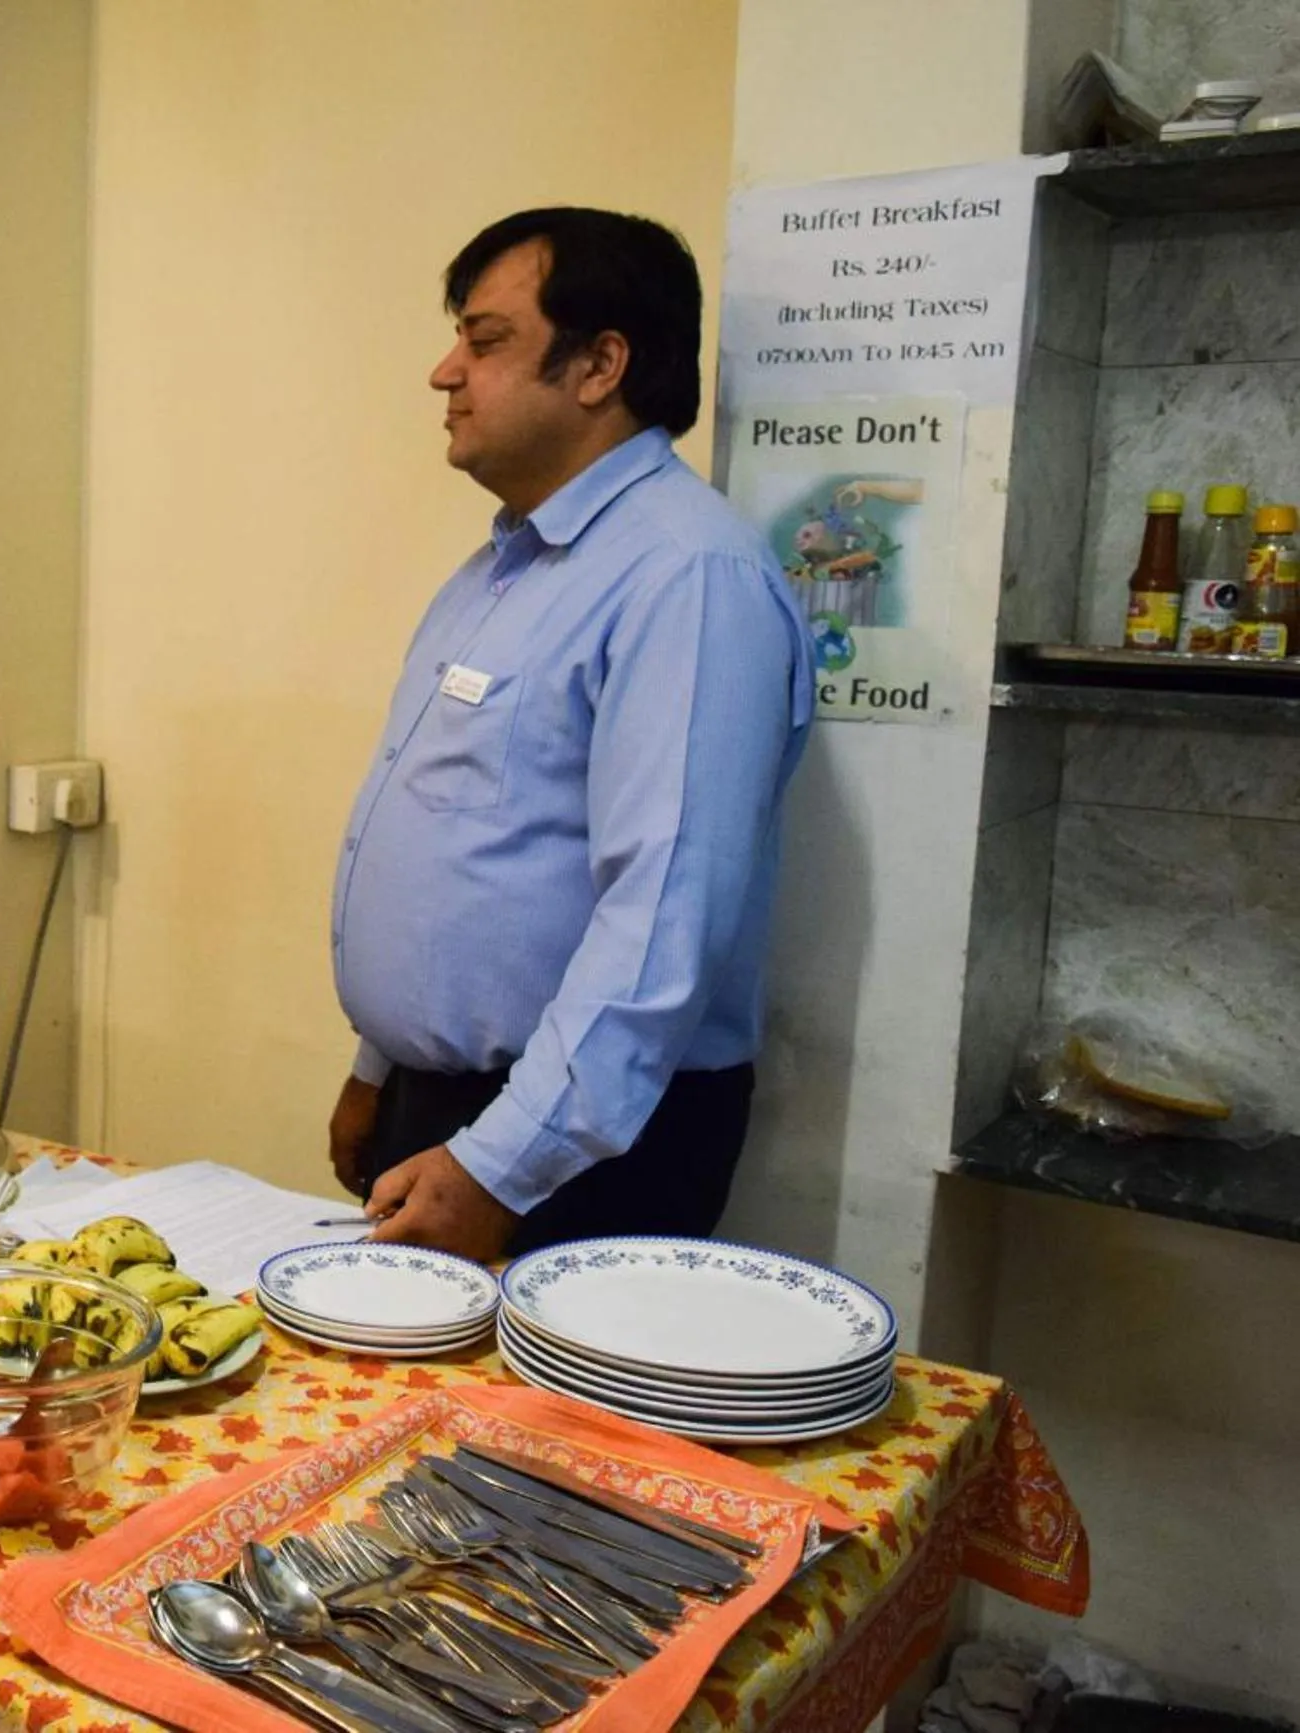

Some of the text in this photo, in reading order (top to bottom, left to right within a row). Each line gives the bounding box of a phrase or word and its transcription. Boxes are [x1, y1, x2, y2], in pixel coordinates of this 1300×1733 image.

[782, 198, 1002, 233] Buffet Breakfast
[876, 254, 937, 275] 240/-
[778, 297, 989, 325] (Including Taxes)
[861, 344, 892, 362] To
[900, 342, 955, 361] 10:45
[963, 341, 1005, 358] Am
[752, 415, 943, 446] Please Don't
[850, 678, 929, 710] Food
